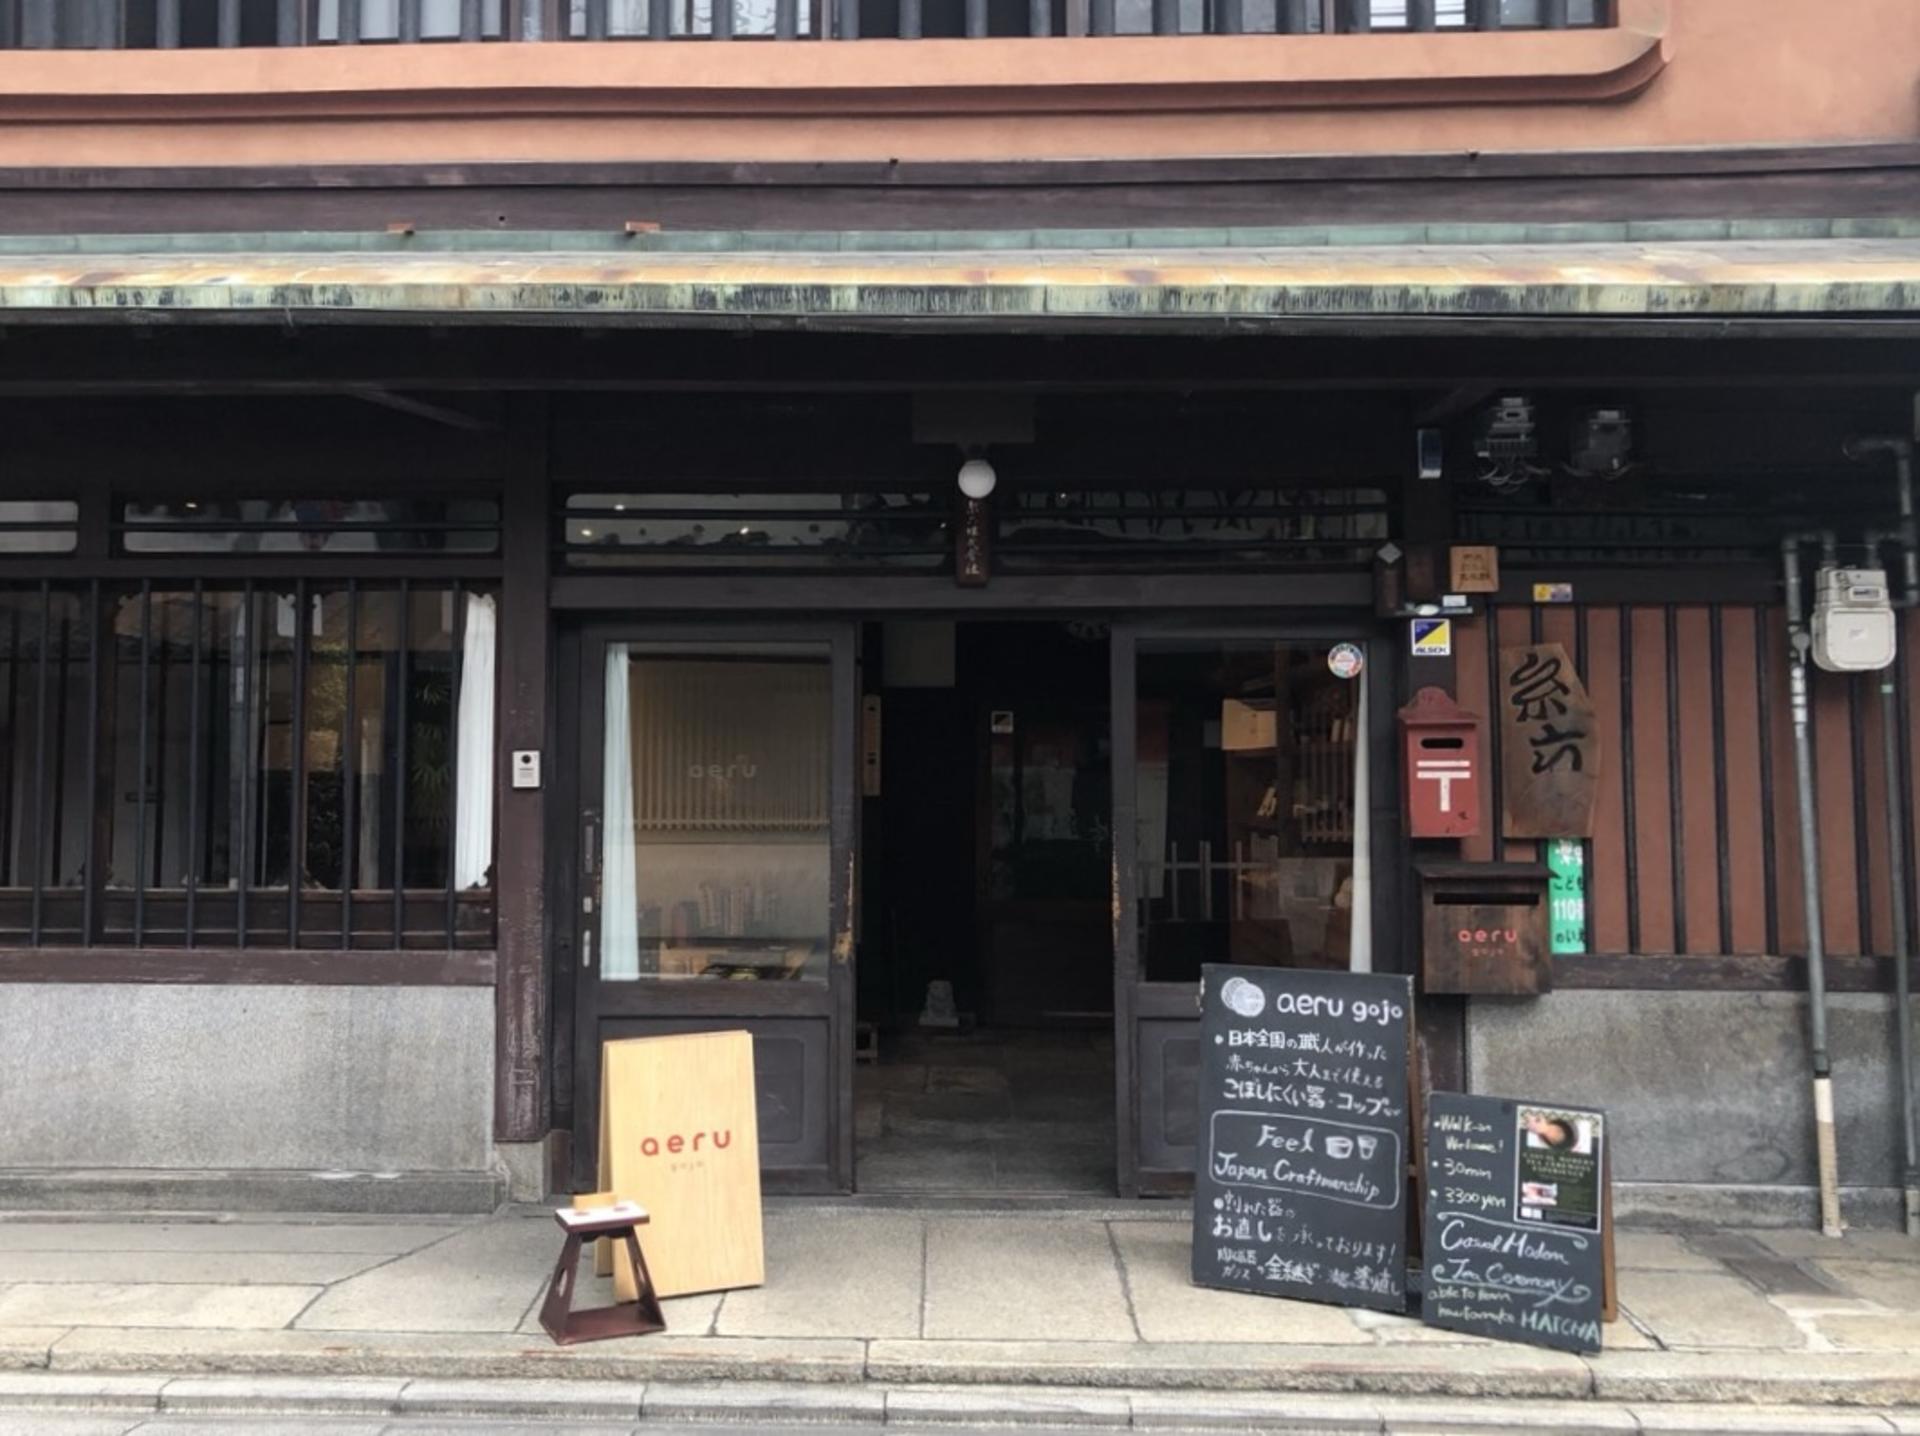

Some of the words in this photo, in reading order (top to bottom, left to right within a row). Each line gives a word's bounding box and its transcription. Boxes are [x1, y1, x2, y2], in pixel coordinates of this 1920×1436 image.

[686, 763, 757, 779] aeru
[1457, 928, 1518, 944] aeru
[1276, 993, 1344, 1018] aeru
[1352, 1000, 1403, 1025] gojo
[1228, 1028, 1388, 1061] 日本全国の職人が作った
[640, 1128, 732, 1157] aeru
[1256, 1125, 1315, 1153] Feel
[1213, 1151, 1269, 1181] Japan
[1521, 1309, 1601, 1345] MATCHA
